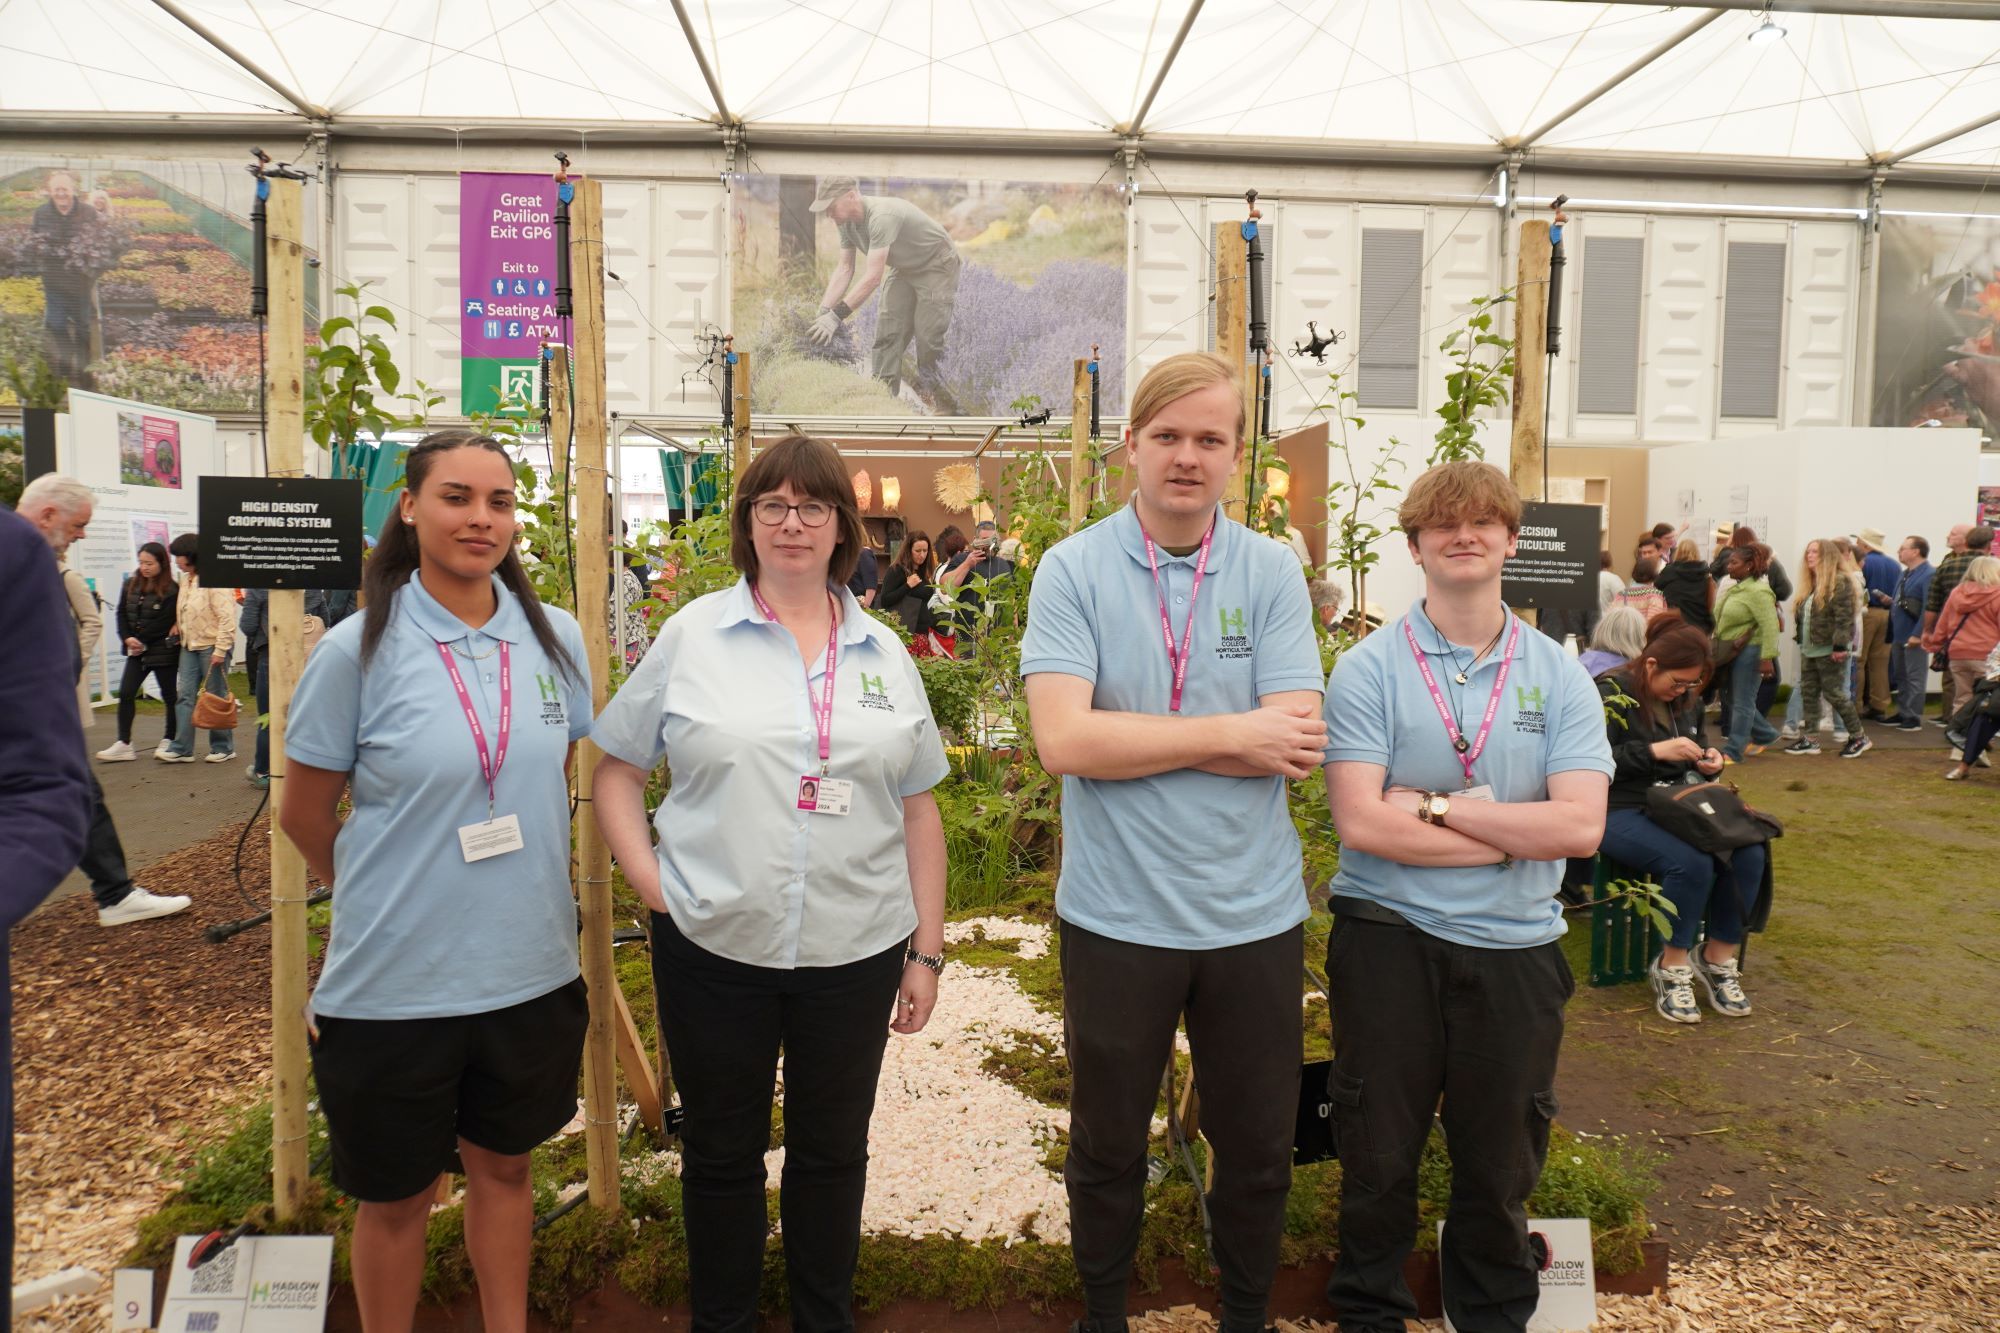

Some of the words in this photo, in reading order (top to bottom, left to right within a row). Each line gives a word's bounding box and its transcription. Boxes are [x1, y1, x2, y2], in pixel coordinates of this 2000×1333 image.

[501, 193, 542, 207] Great
[493, 209, 549, 223] Pavilion
[491, 226, 518, 239] Exit
[522, 226, 552, 239] GP6
[502, 262, 524, 273] Exit
[528, 263, 538, 273] to
[488, 303, 539, 320] Seating
[526, 325, 558, 338] ATM
[242, 501, 268, 512] HIGH
[271, 502, 319, 514] DENSITY
[228, 516, 285, 528] CROPPING
[287, 517, 332, 528] SYSTEM
[1425, 670, 1434, 687] SHOWS
[1438, 702, 1449, 719] SHOWS
[1476, 730, 1486, 748] SHOWS
[1541, 1270, 1585, 1280] COLLEGE
[272, 1281, 320, 1291] HADLOW
[270, 1291, 318, 1302] COLLEGE
[126, 1301, 139, 1320] 9
